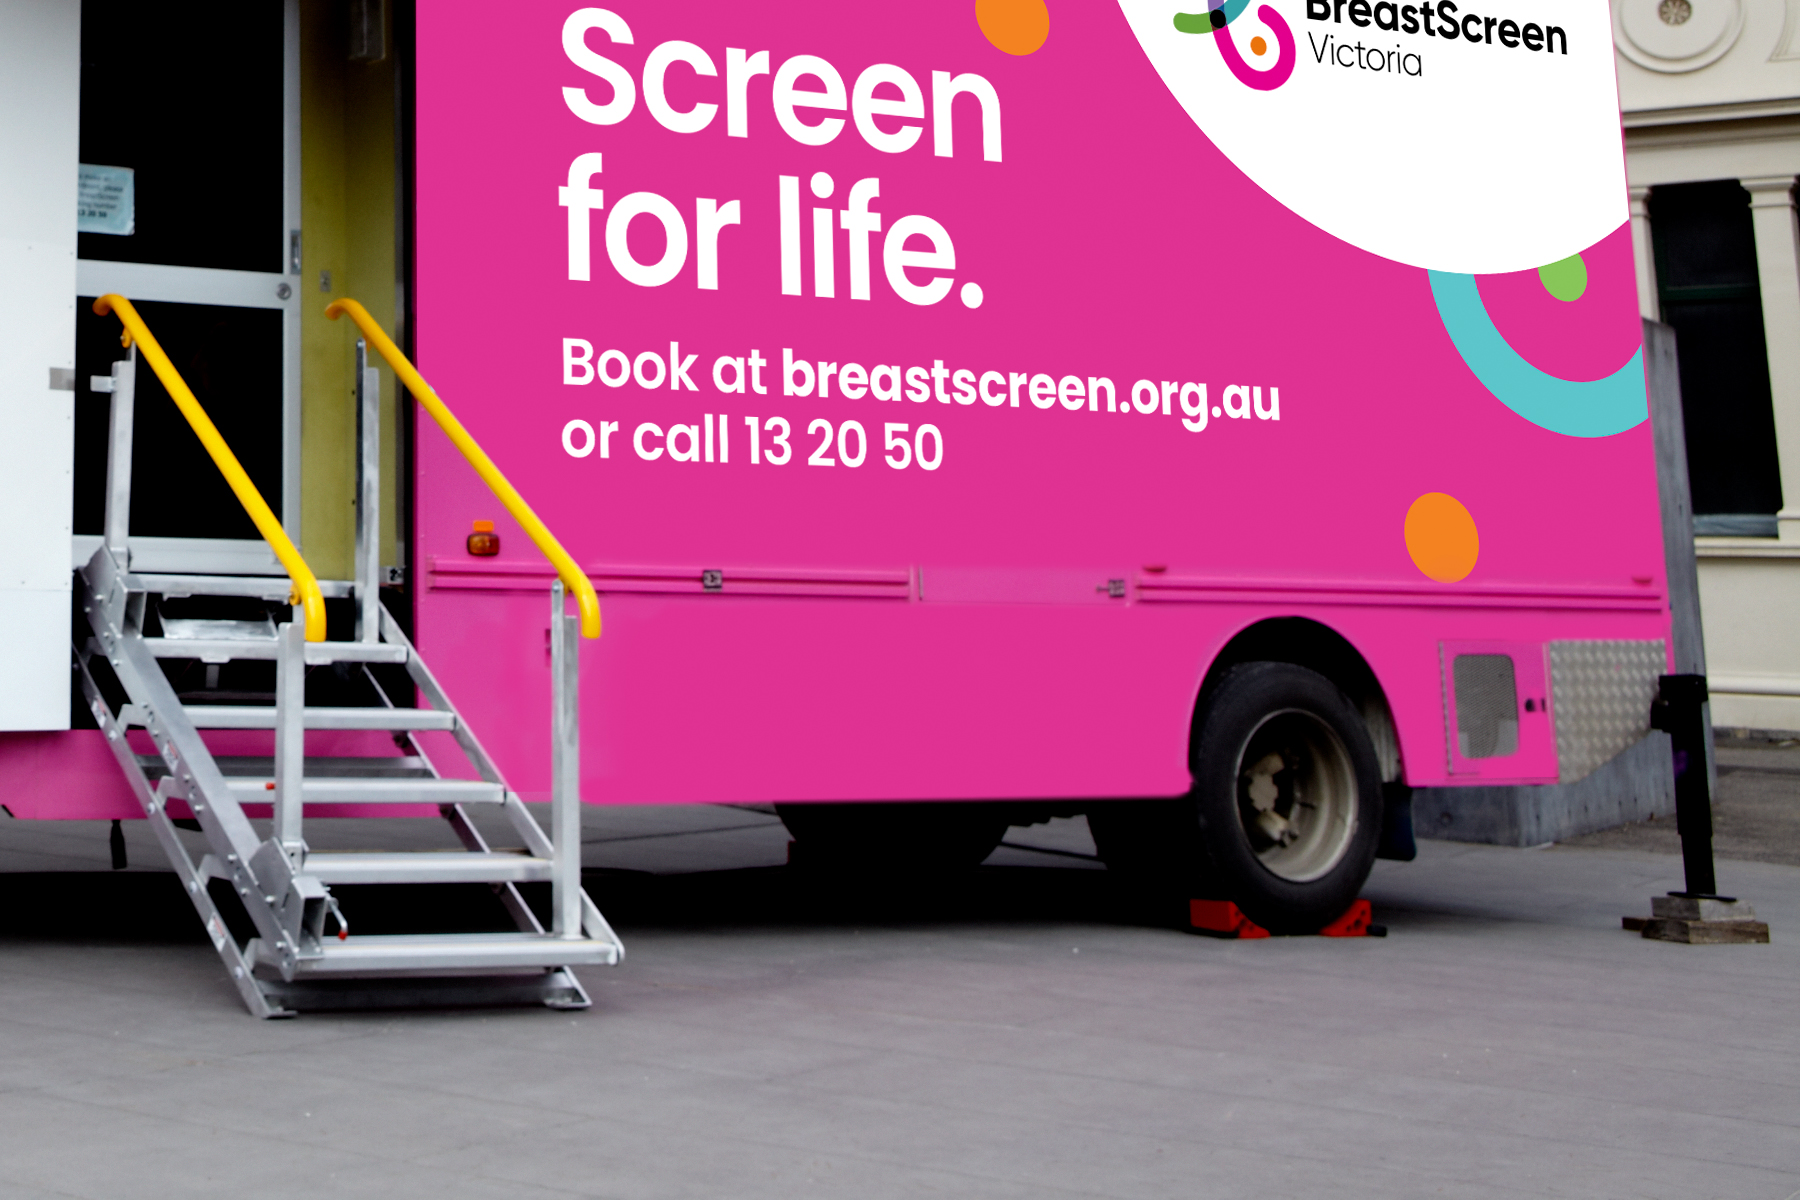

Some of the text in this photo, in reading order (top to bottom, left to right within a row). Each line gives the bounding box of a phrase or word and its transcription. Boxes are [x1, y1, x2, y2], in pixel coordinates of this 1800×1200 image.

[562, 8, 1002, 162] Screen
[1307, 31, 1422, 76] Victoria
[559, 152, 983, 309] for life.
[563, 338, 1280, 432] Book at breastscreen.org.au
[562, 414, 943, 470] or call 13 20 50
